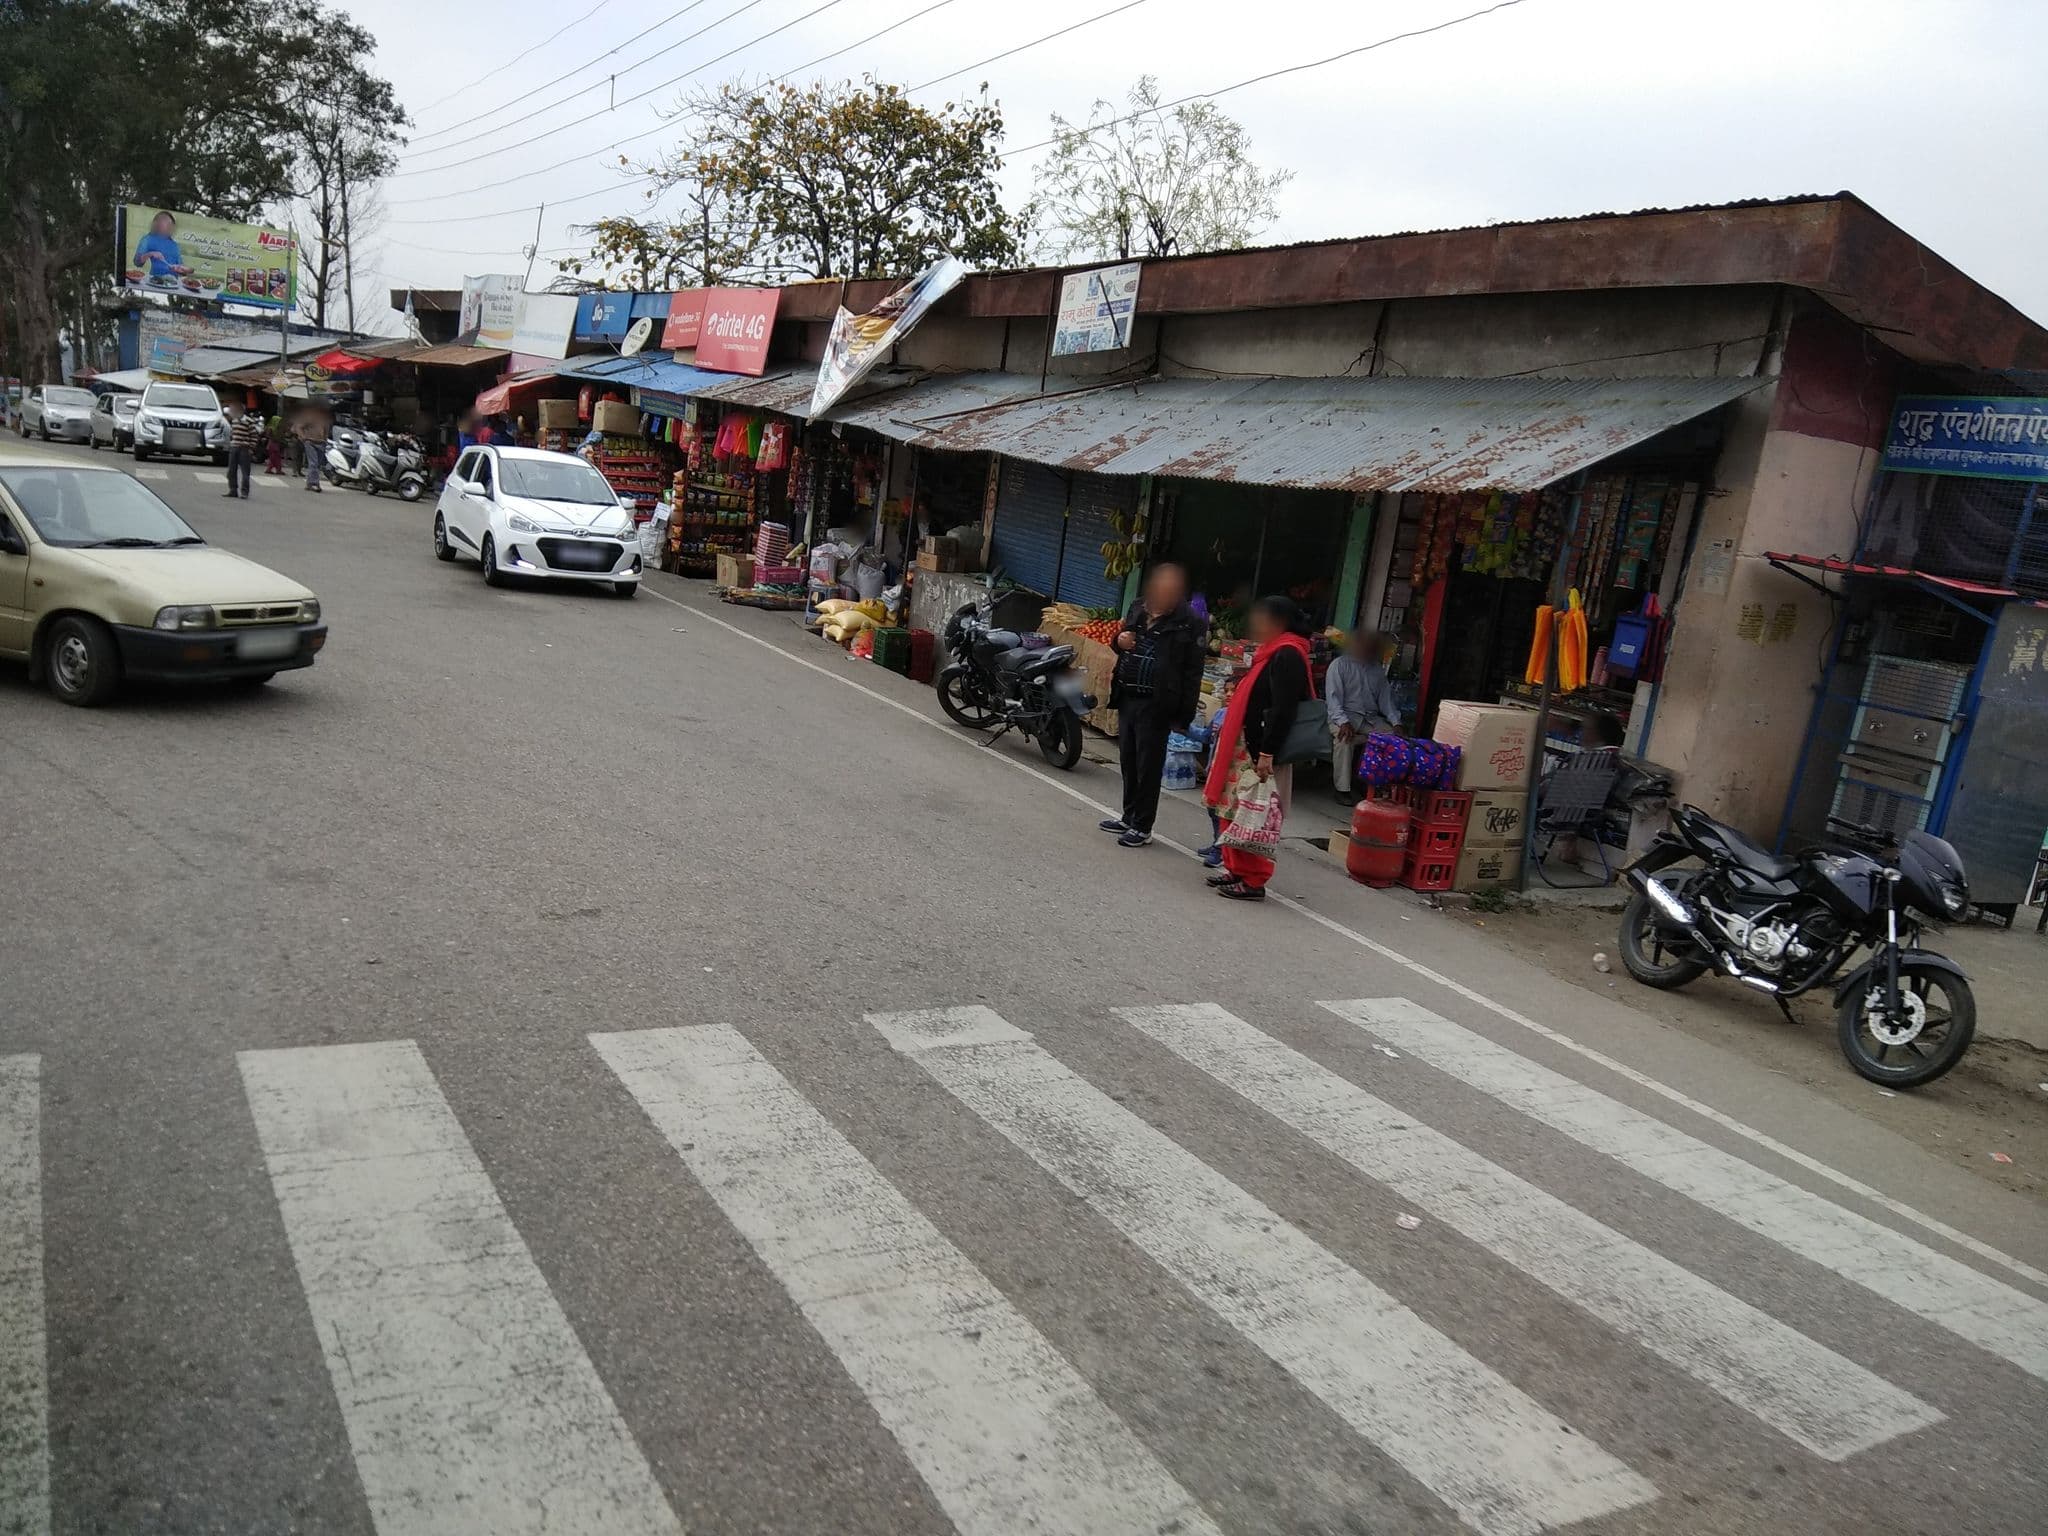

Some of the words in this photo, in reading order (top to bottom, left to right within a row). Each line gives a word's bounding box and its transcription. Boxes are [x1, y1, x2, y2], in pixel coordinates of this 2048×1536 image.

[717, 310, 744, 337] airtel
[745, 313, 766, 340] 4G
[1488, 808, 1518, 833] KitKat
